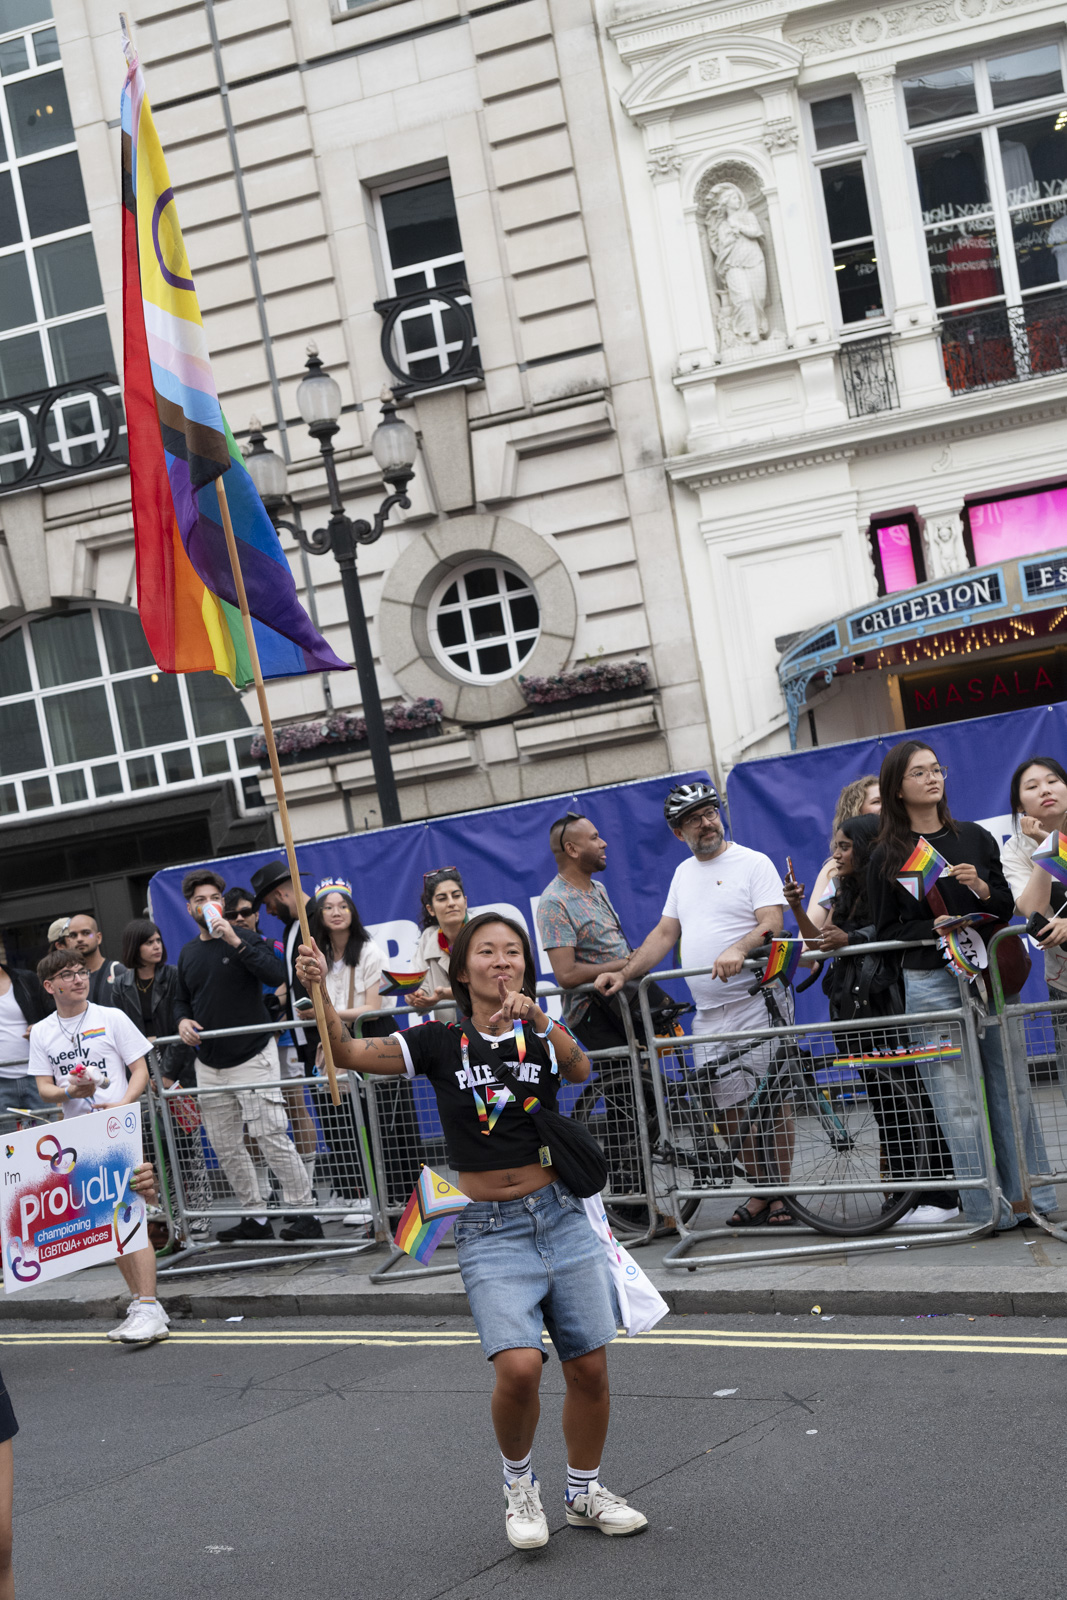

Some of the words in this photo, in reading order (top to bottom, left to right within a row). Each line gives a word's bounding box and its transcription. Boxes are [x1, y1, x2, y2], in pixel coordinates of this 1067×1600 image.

[861, 577, 992, 634] CRITERION
[914, 666, 1053, 712] MASALA
[59, 1058, 106, 1076] Beved
[455, 1061, 542, 1090] PALENE
[4, 1171, 21, 1186] I'm
[37, 1219, 91, 1243] championing
[40, 1239, 81, 1260] LGBTQIA+
[82, 1231, 109, 1246] voices
